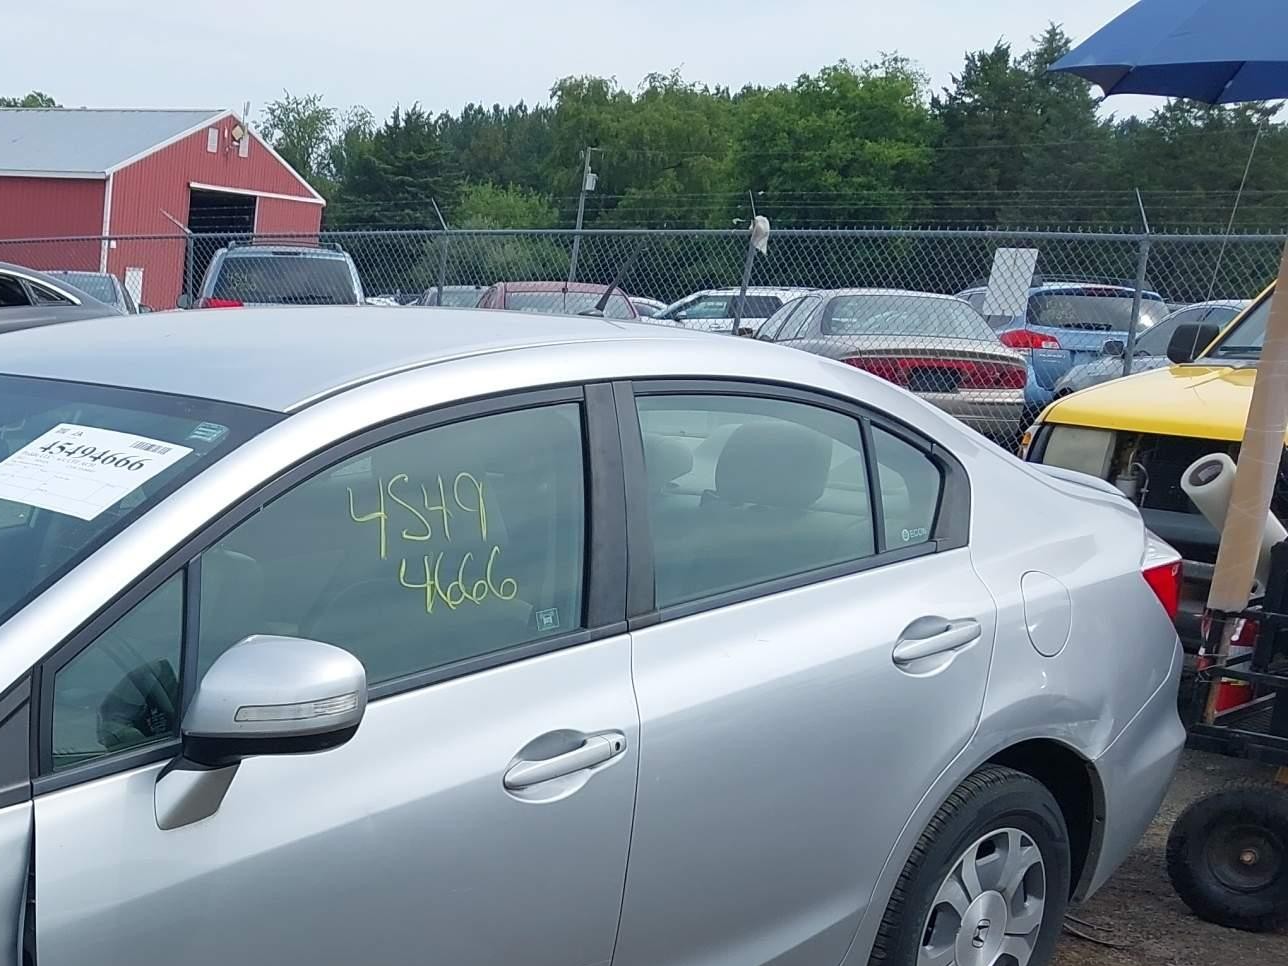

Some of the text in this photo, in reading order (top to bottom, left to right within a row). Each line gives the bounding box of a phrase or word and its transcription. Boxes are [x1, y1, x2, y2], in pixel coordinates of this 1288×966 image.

[39, 440, 153, 471] 45494666
[346, 472, 488, 560] 4549
[398, 545, 518, 614] 4666
